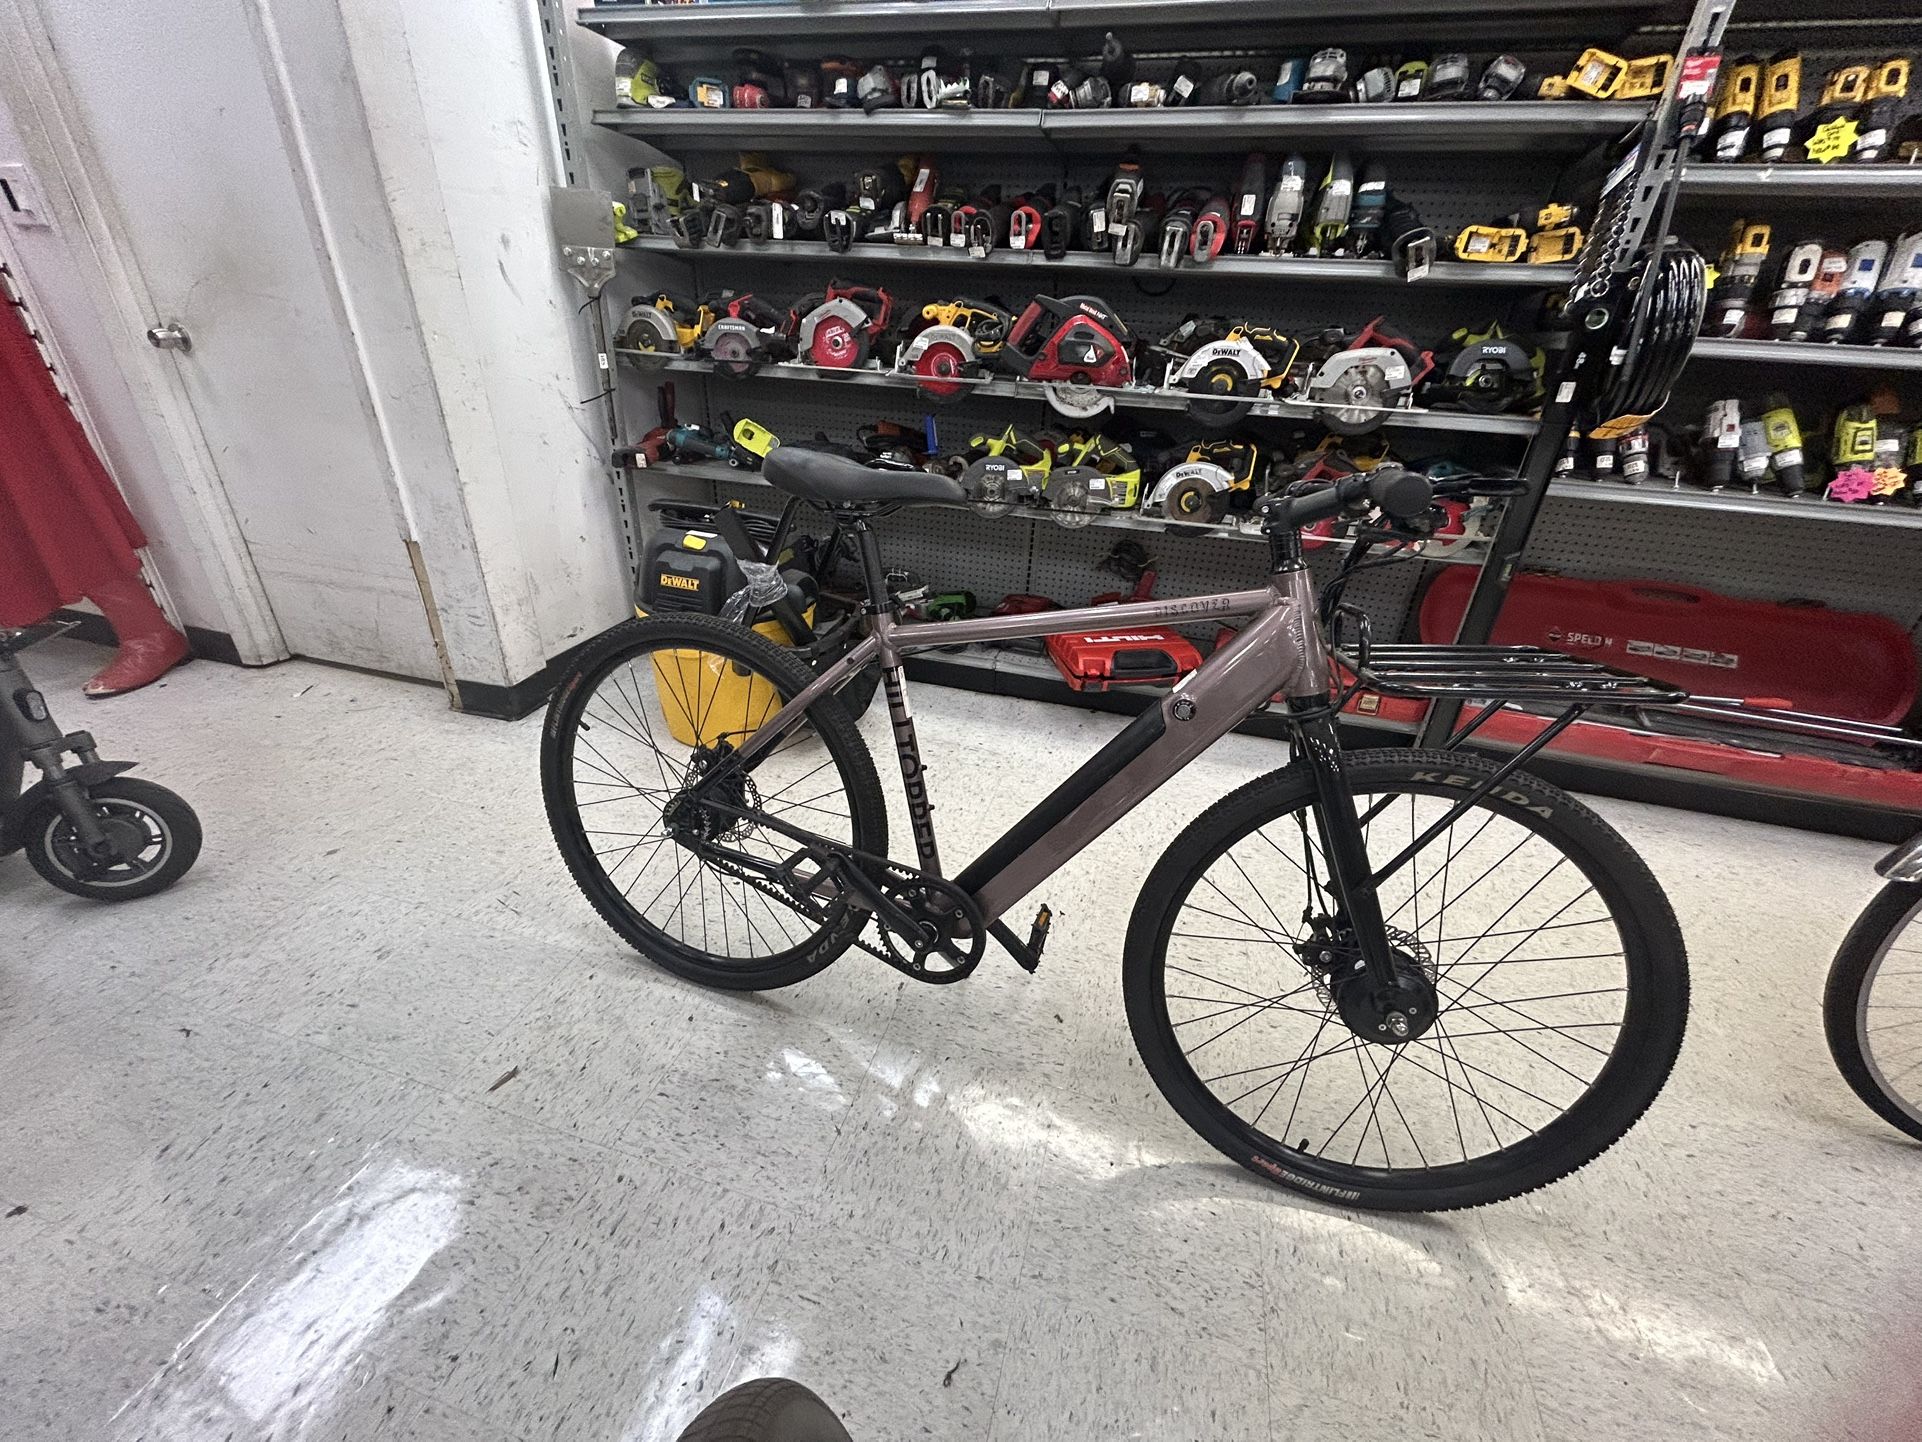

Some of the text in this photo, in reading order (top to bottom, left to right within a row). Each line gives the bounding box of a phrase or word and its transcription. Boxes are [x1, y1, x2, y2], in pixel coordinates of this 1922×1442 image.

[718, 323, 746, 332] CRAFTSMAN
[1482, 346, 1506, 354] RYOBI
[985, 464, 1006, 472] RYOBI
[660, 573, 699, 592] DEWALT
[1153, 598, 1231, 618] DISCOVER
[1083, 634, 1166, 644] HILTI
